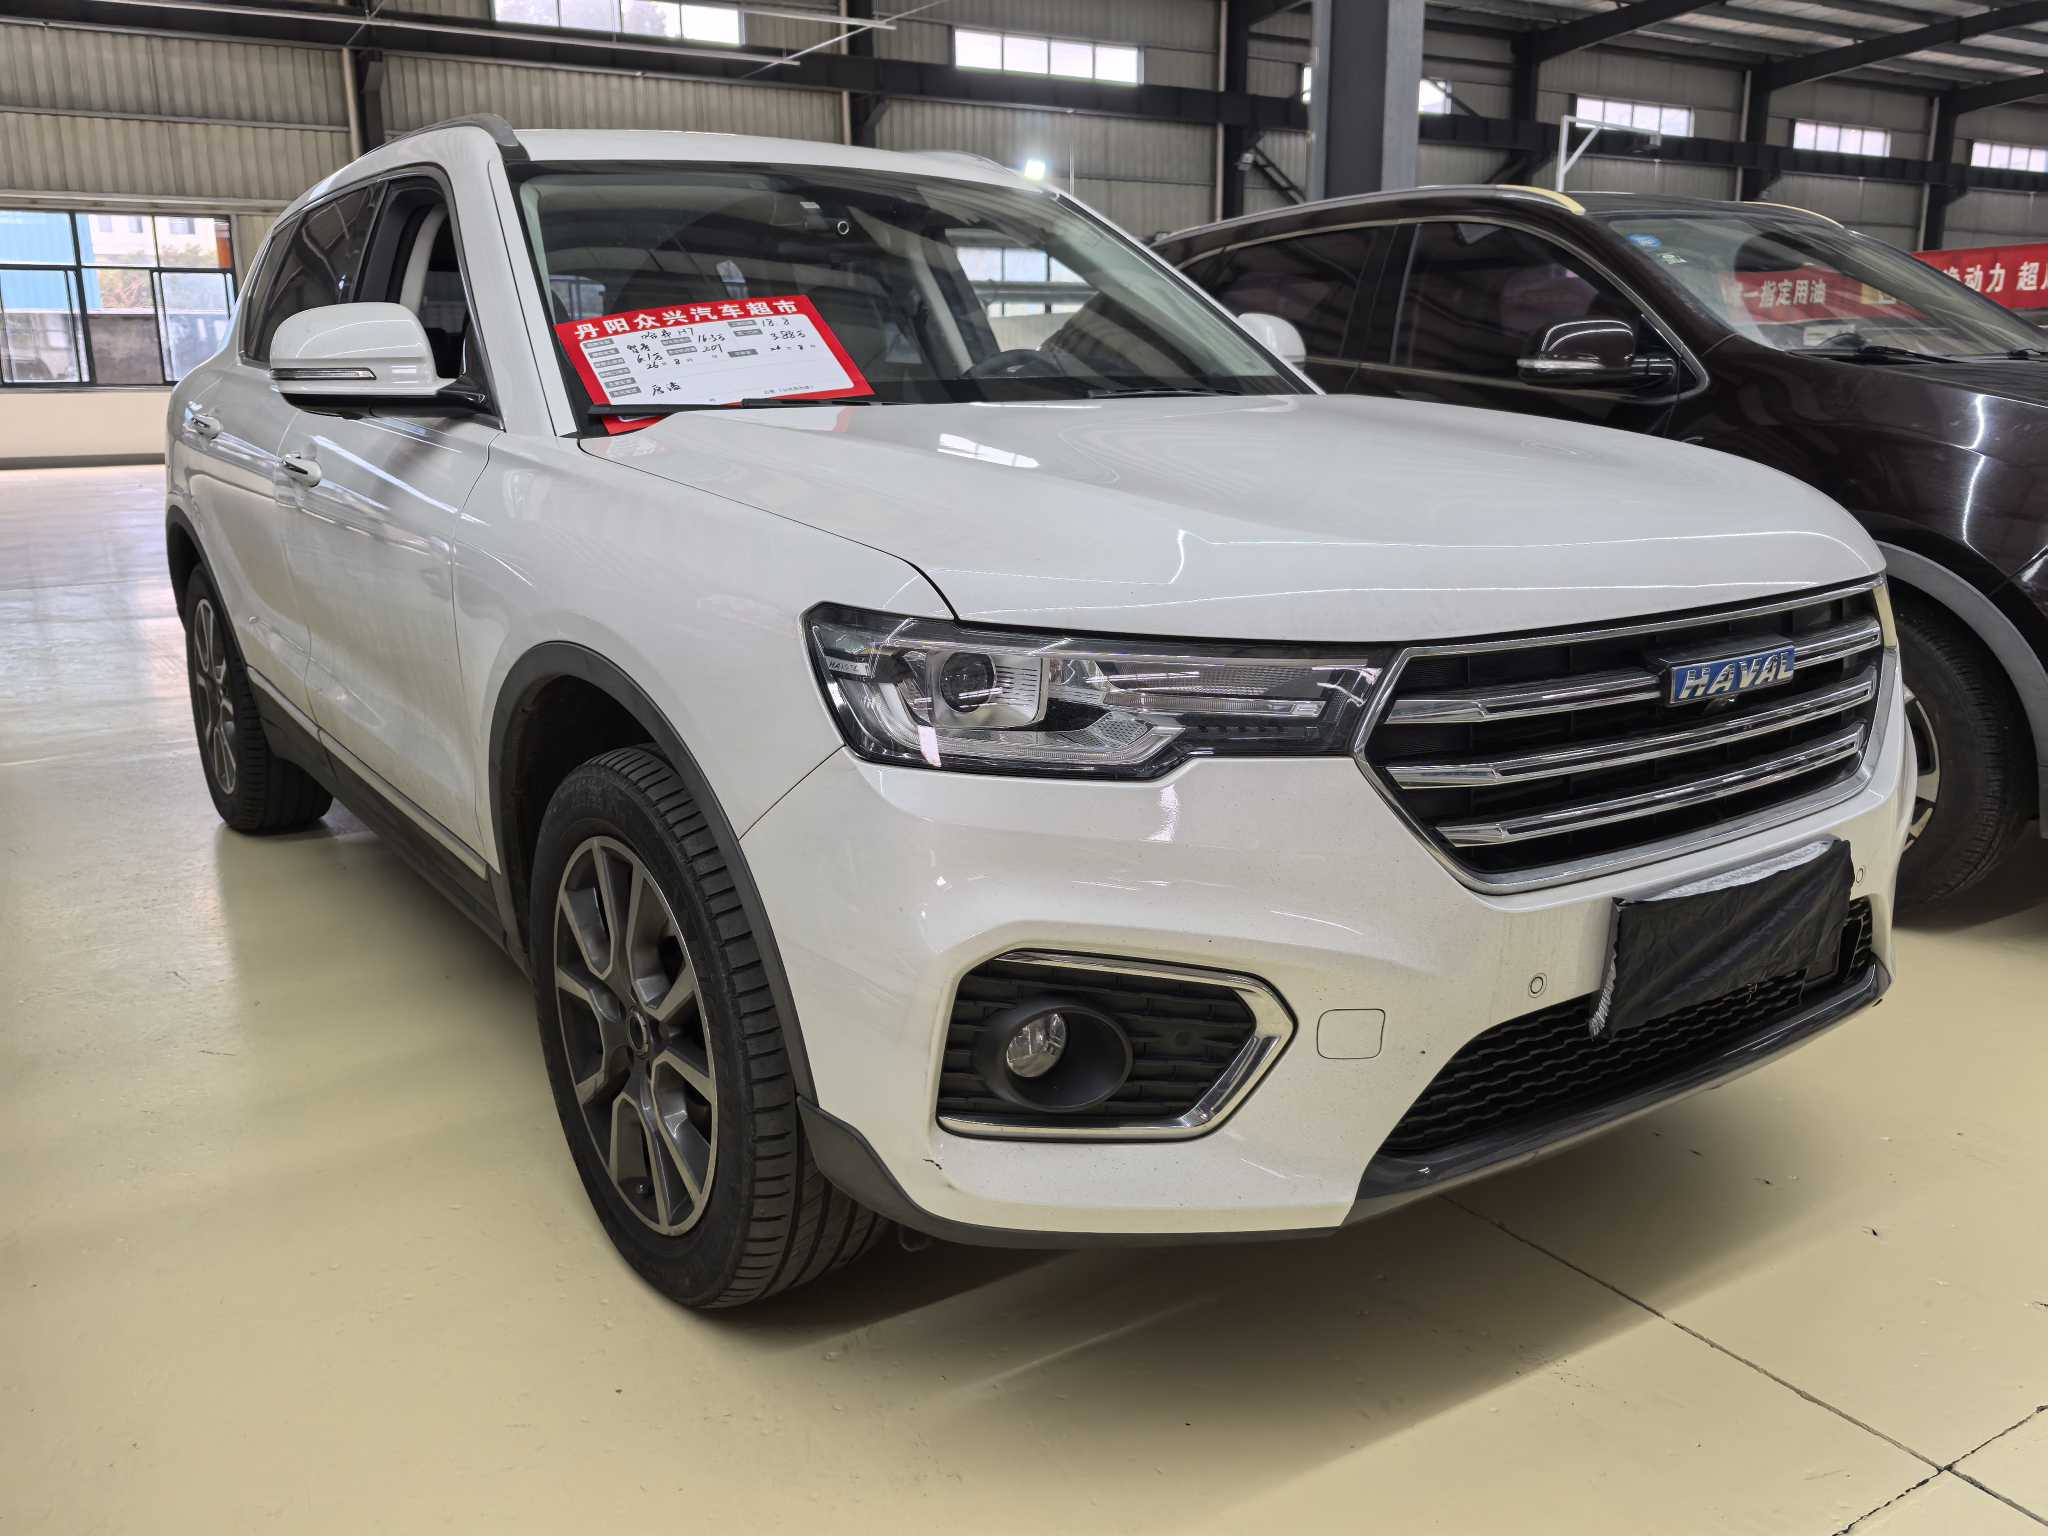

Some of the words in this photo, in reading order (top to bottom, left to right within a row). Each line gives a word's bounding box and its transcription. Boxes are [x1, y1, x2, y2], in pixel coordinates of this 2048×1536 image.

[2016, 261, 2048, 291] 超
[574, 301, 798, 340] 丹阳众兴汽车超市
[1678, 651, 1794, 699] HAVAL
